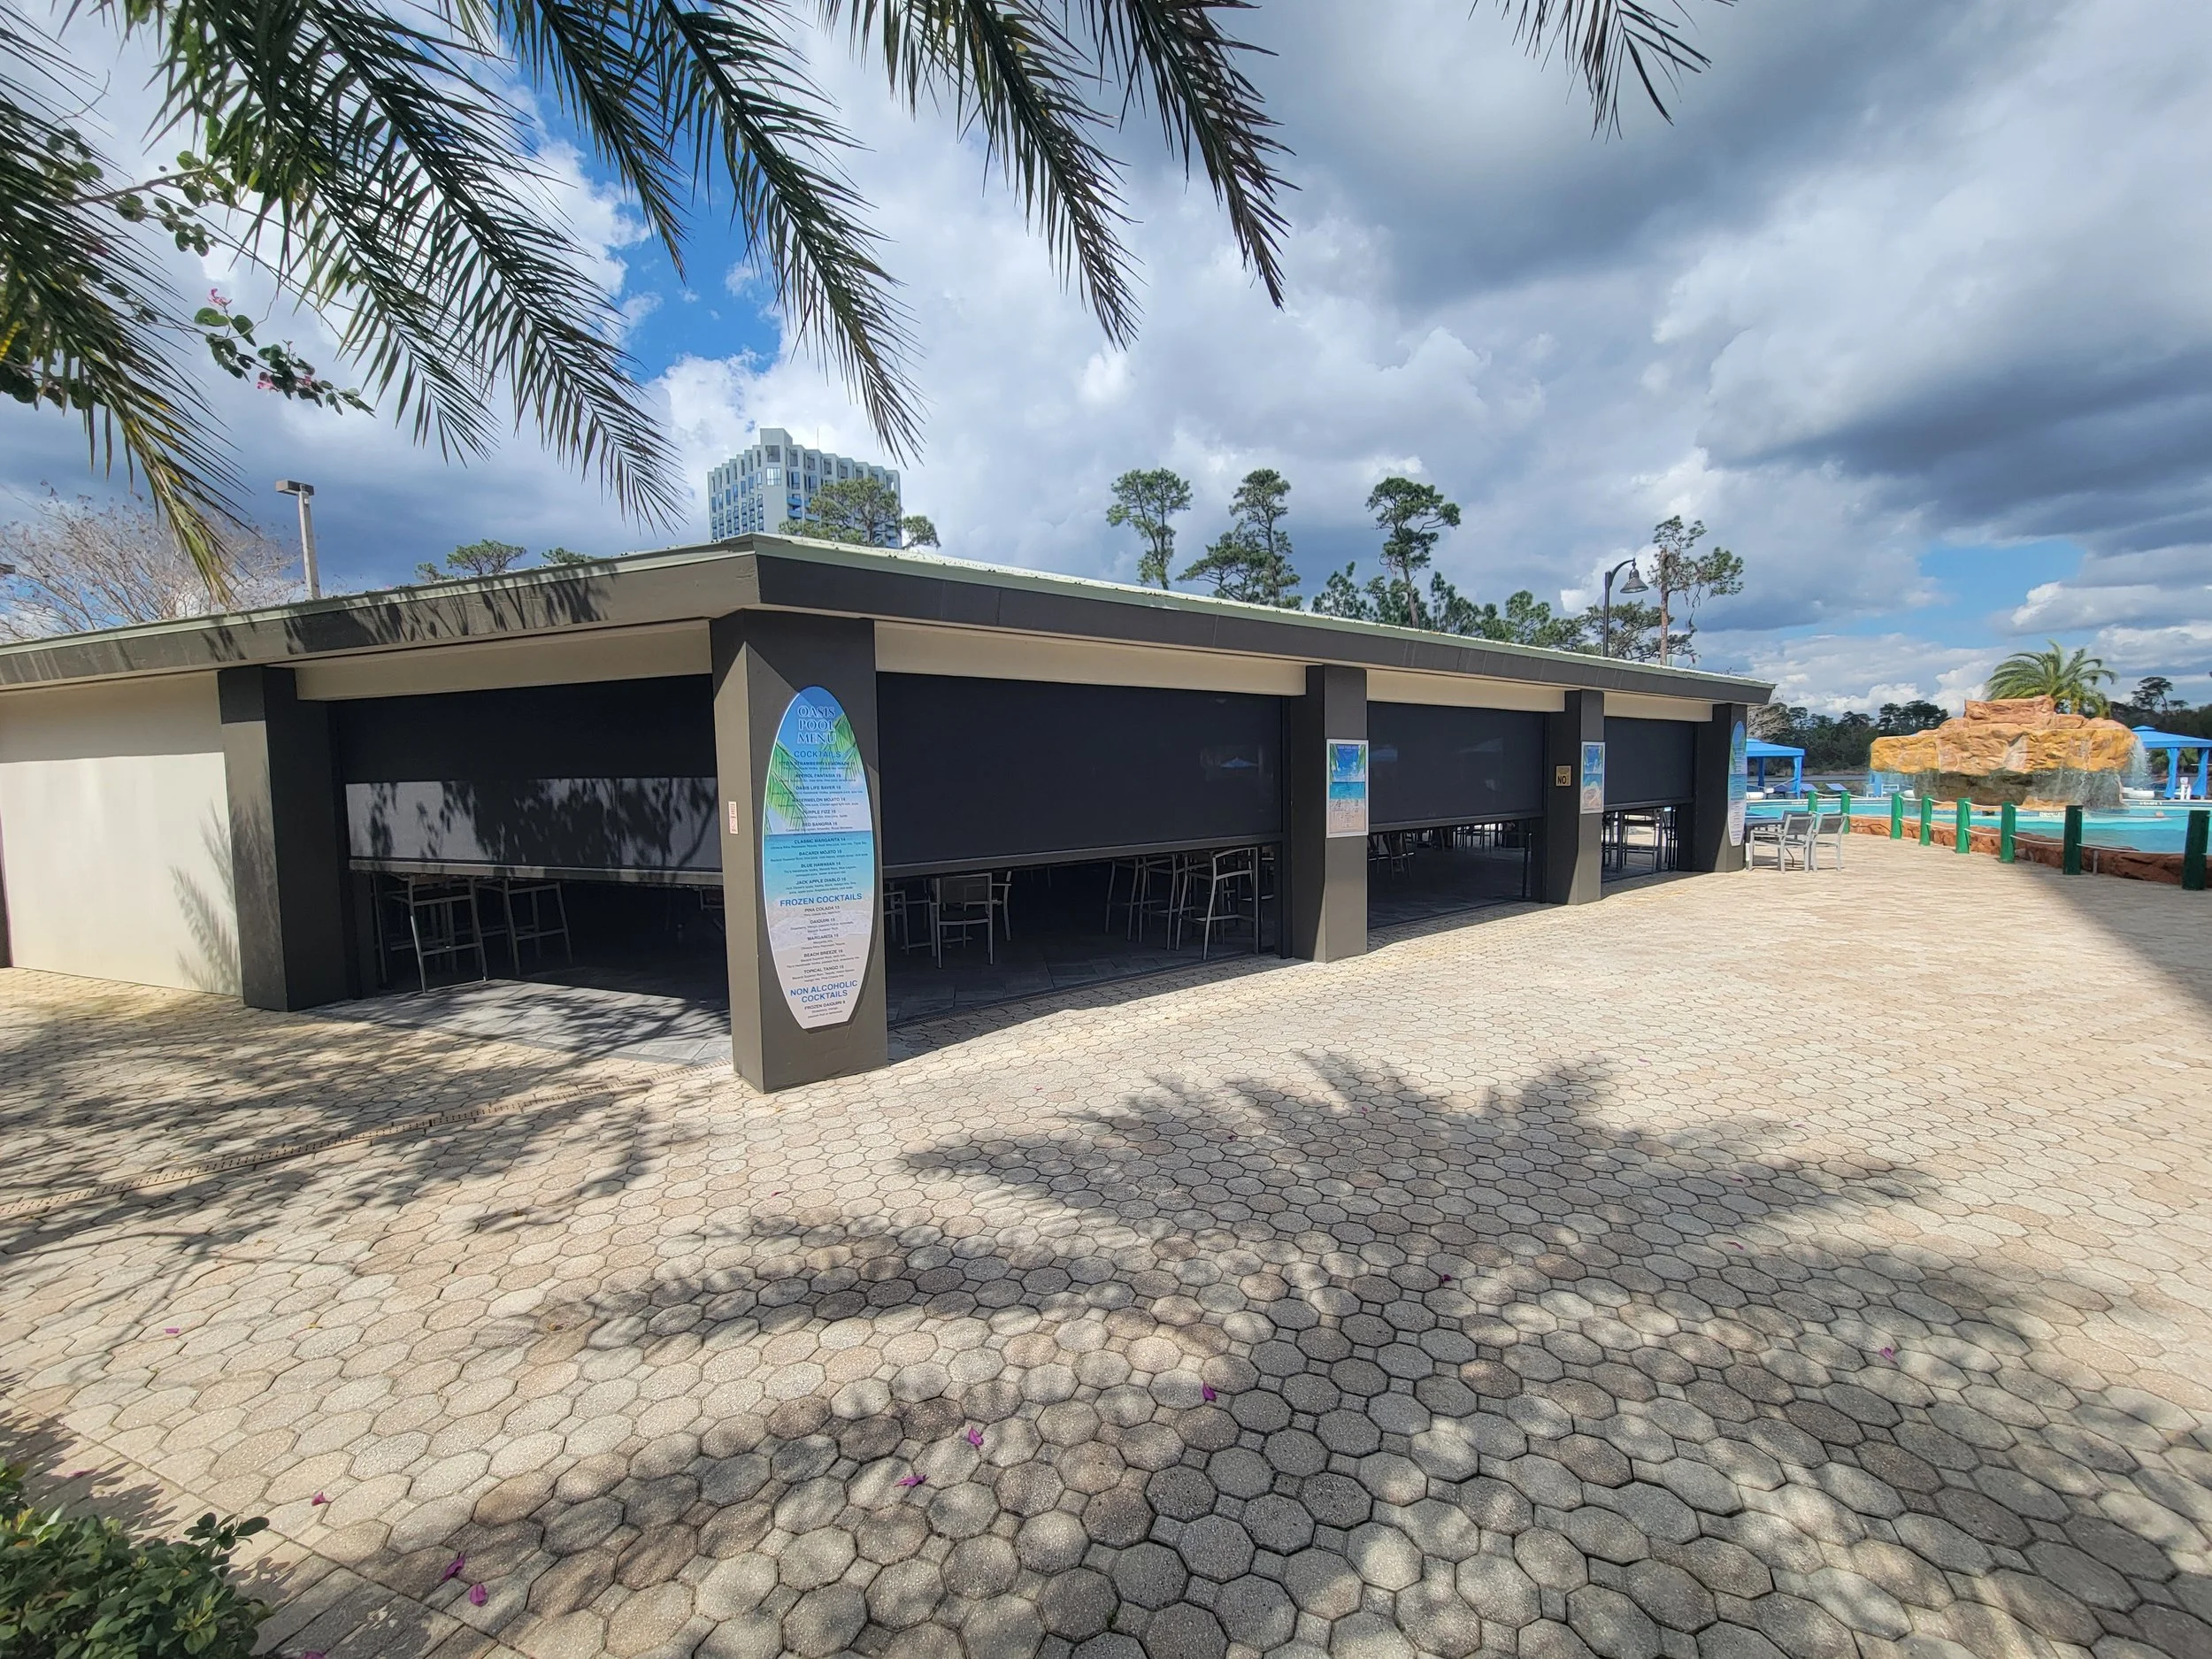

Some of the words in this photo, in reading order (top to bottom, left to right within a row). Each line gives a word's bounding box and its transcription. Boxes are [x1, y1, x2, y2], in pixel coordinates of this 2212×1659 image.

[797, 705, 836, 718] OASIS
[798, 718, 836, 732] POOL
[797, 731, 837, 745] MENU
[1557, 775, 1567, 785] NO
[780, 897, 815, 907] FROZEN
[816, 893, 863, 904] COCKTAILS
[790, 987, 810, 997] NON
[810, 979, 858, 994] ALCOHOLIC
[801, 989, 849, 1003] COCKTAILS
